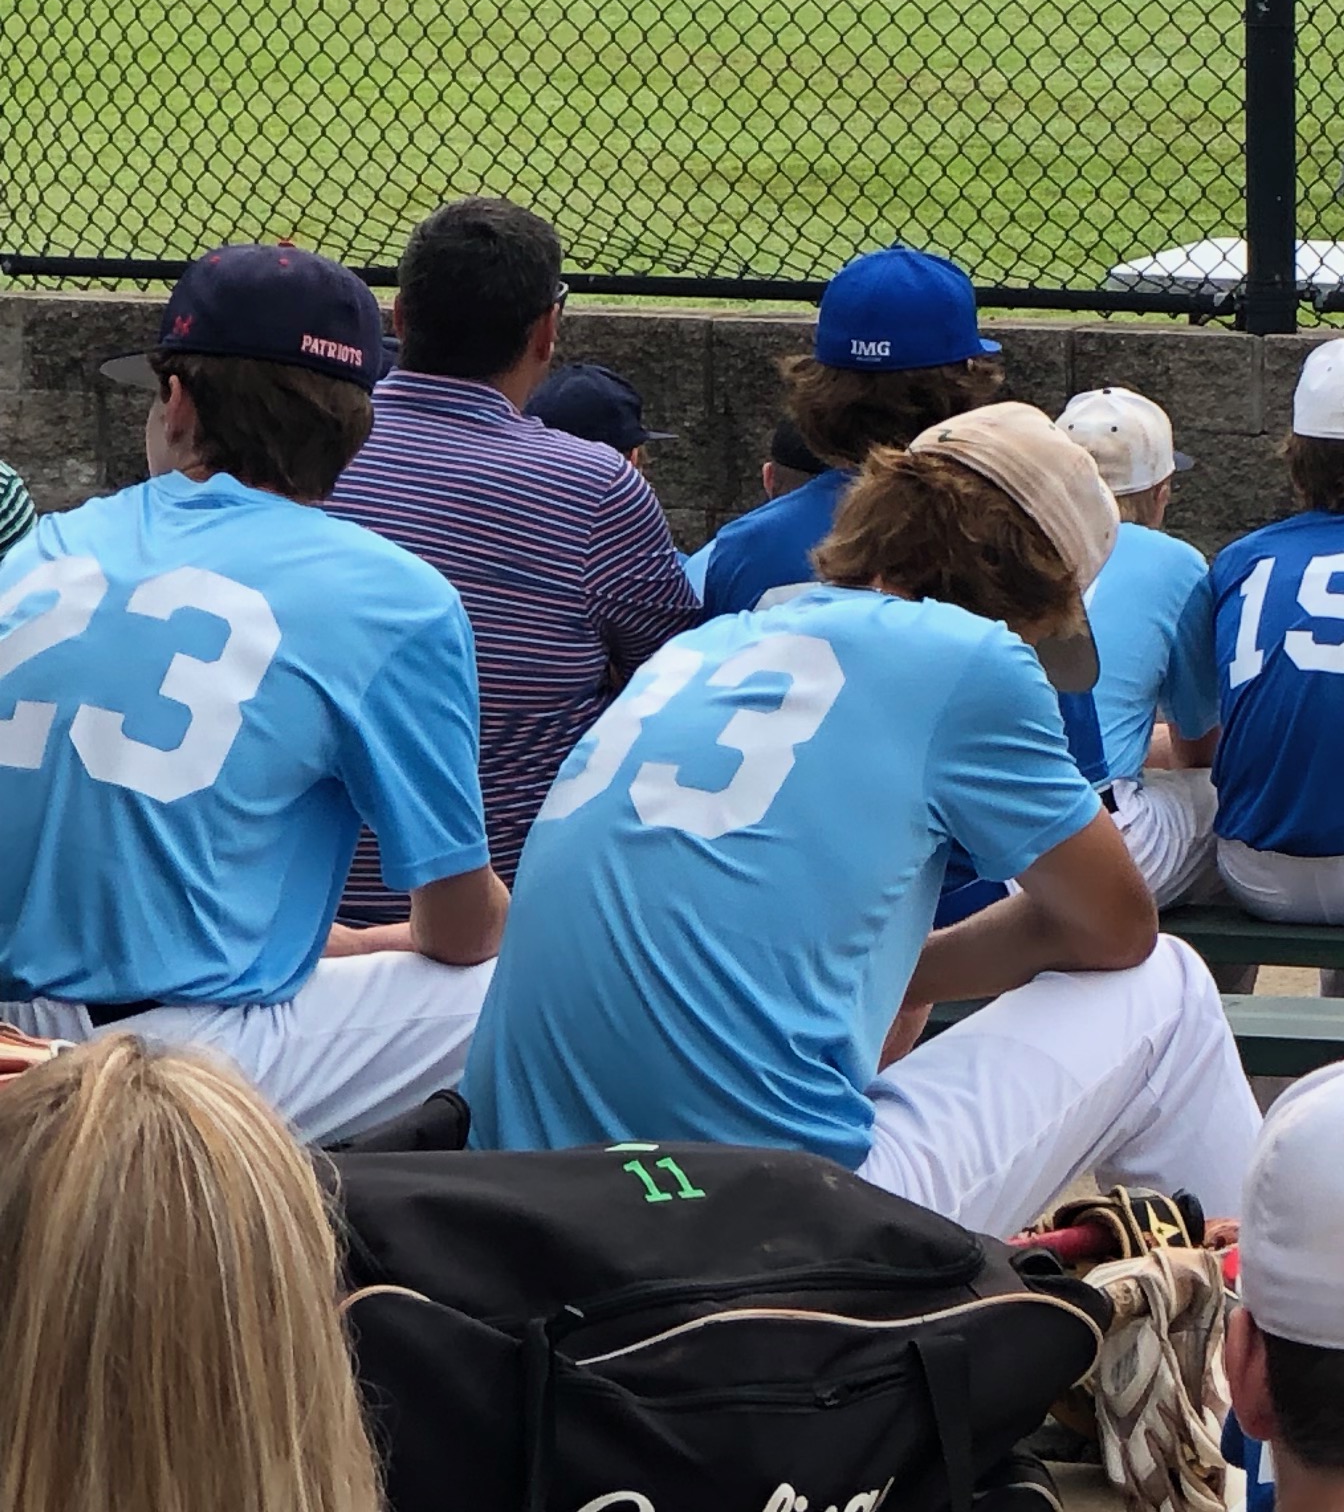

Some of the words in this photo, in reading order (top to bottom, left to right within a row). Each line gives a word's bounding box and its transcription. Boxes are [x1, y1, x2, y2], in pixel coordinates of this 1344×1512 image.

[301, 334, 363, 367] PATRIOTS
[850, 339, 892, 356] IMG
[0, 555, 282, 804] 23
[623, 1156, 706, 1203] 11
